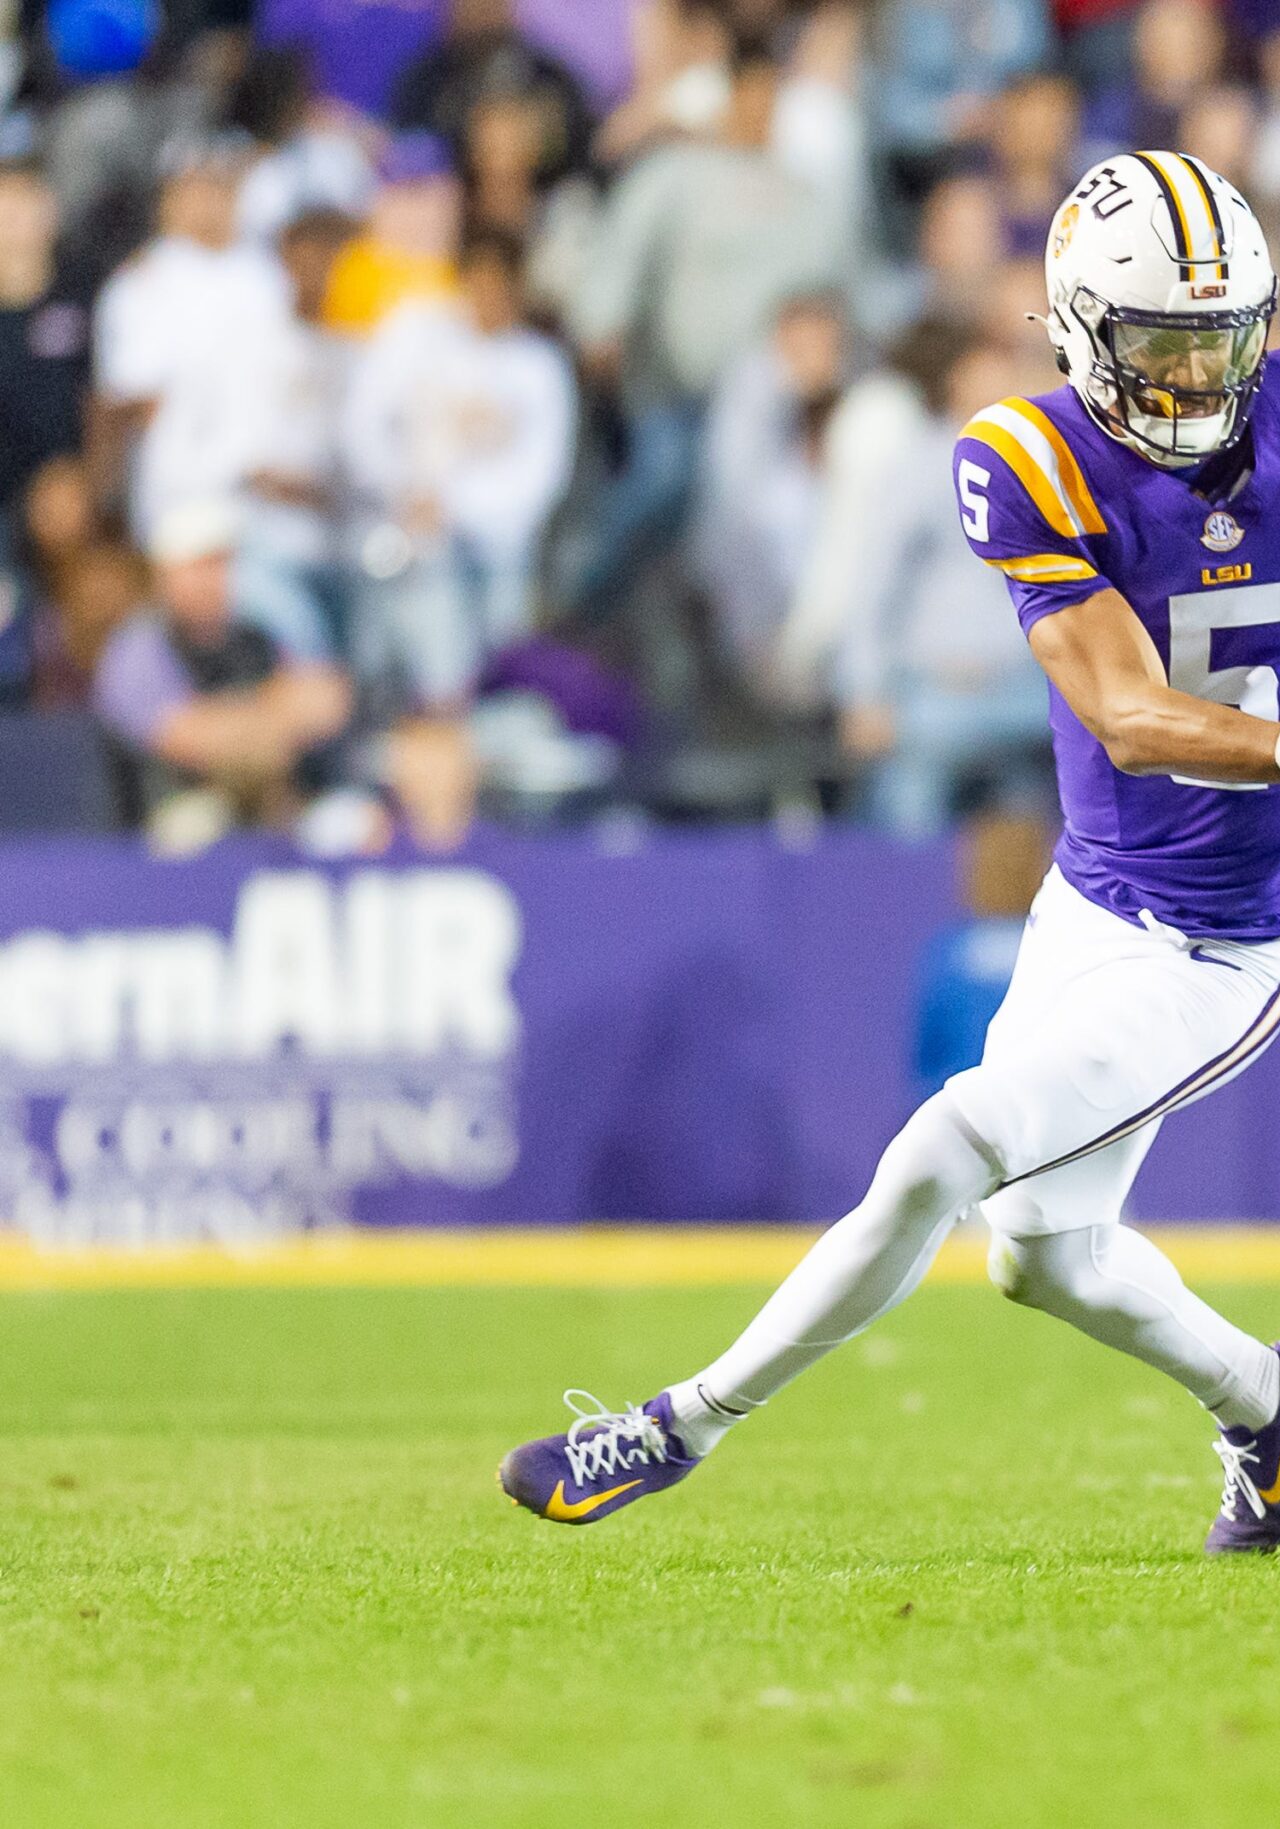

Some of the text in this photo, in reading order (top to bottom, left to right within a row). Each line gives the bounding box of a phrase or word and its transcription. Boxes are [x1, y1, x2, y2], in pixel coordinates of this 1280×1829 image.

[1191, 286, 1227, 300] LSU
[958, 458, 991, 543] 5
[1202, 562, 1252, 586] LSU
